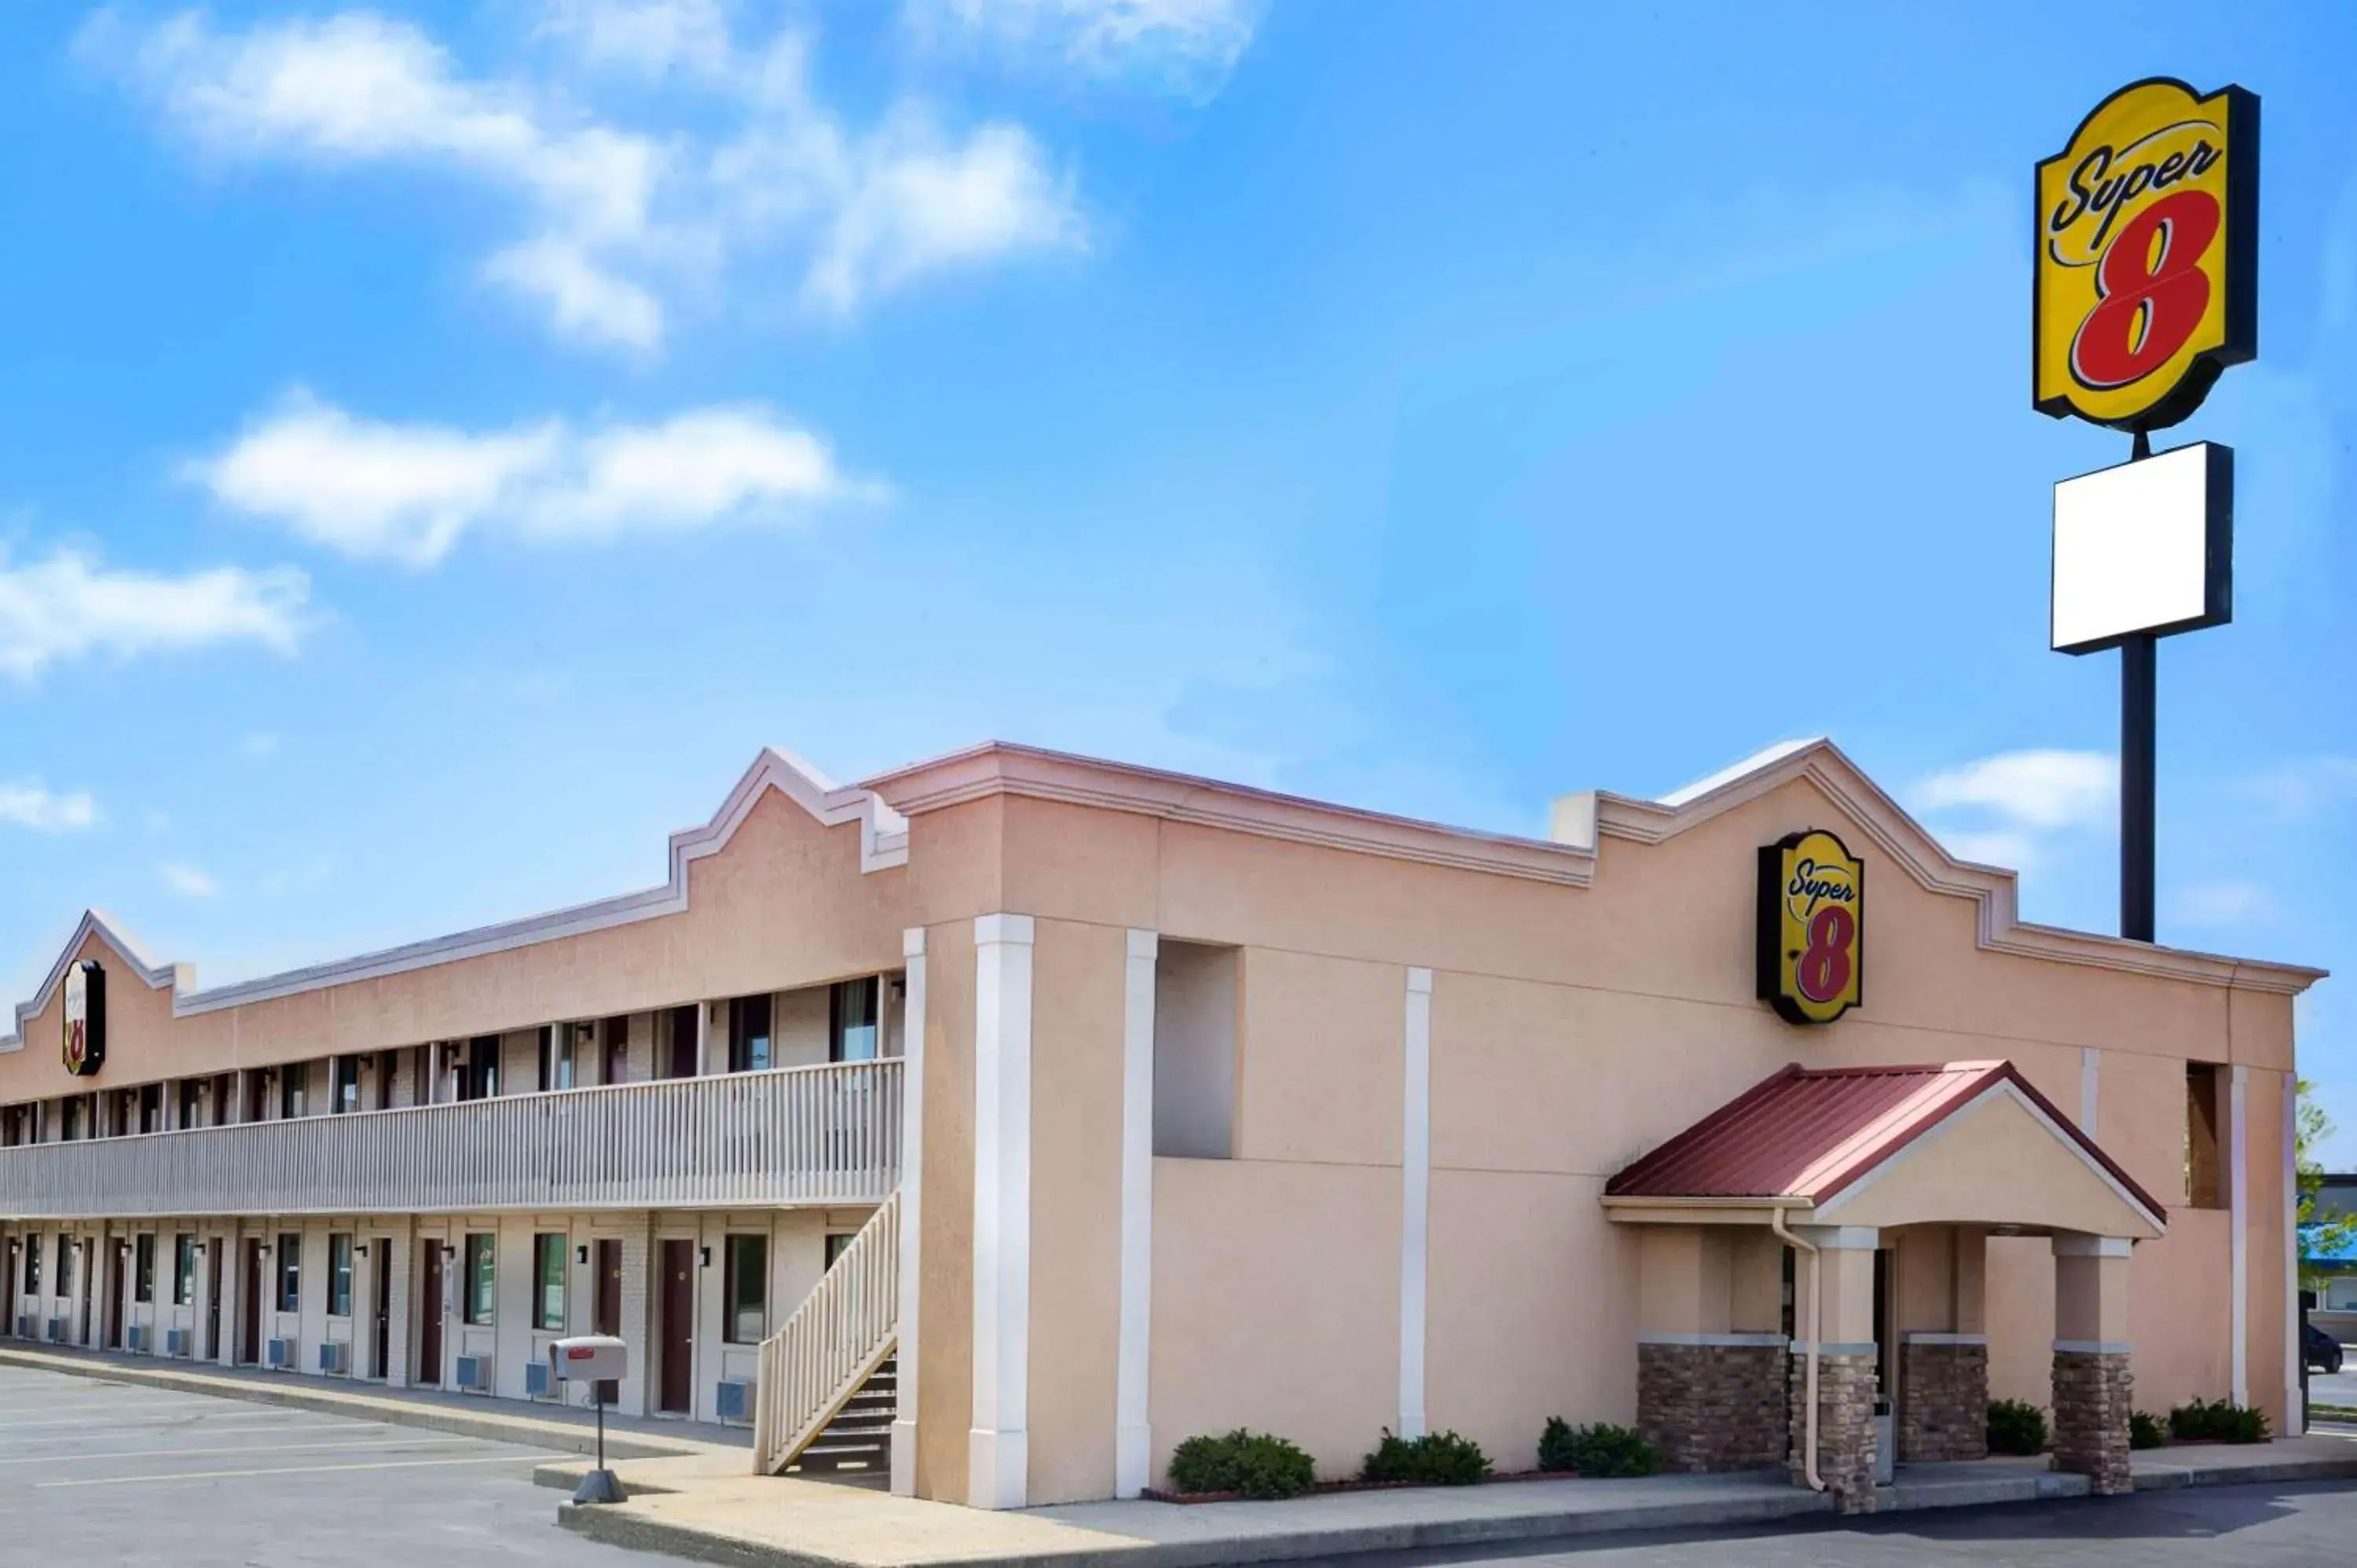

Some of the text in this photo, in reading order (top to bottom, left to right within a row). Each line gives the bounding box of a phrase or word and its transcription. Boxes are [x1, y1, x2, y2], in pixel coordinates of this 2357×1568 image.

[2051, 138, 2223, 253] Super
[2069, 190, 2221, 391] 8
[1787, 857, 1855, 918] Super
[1797, 906, 1855, 1003] 8
